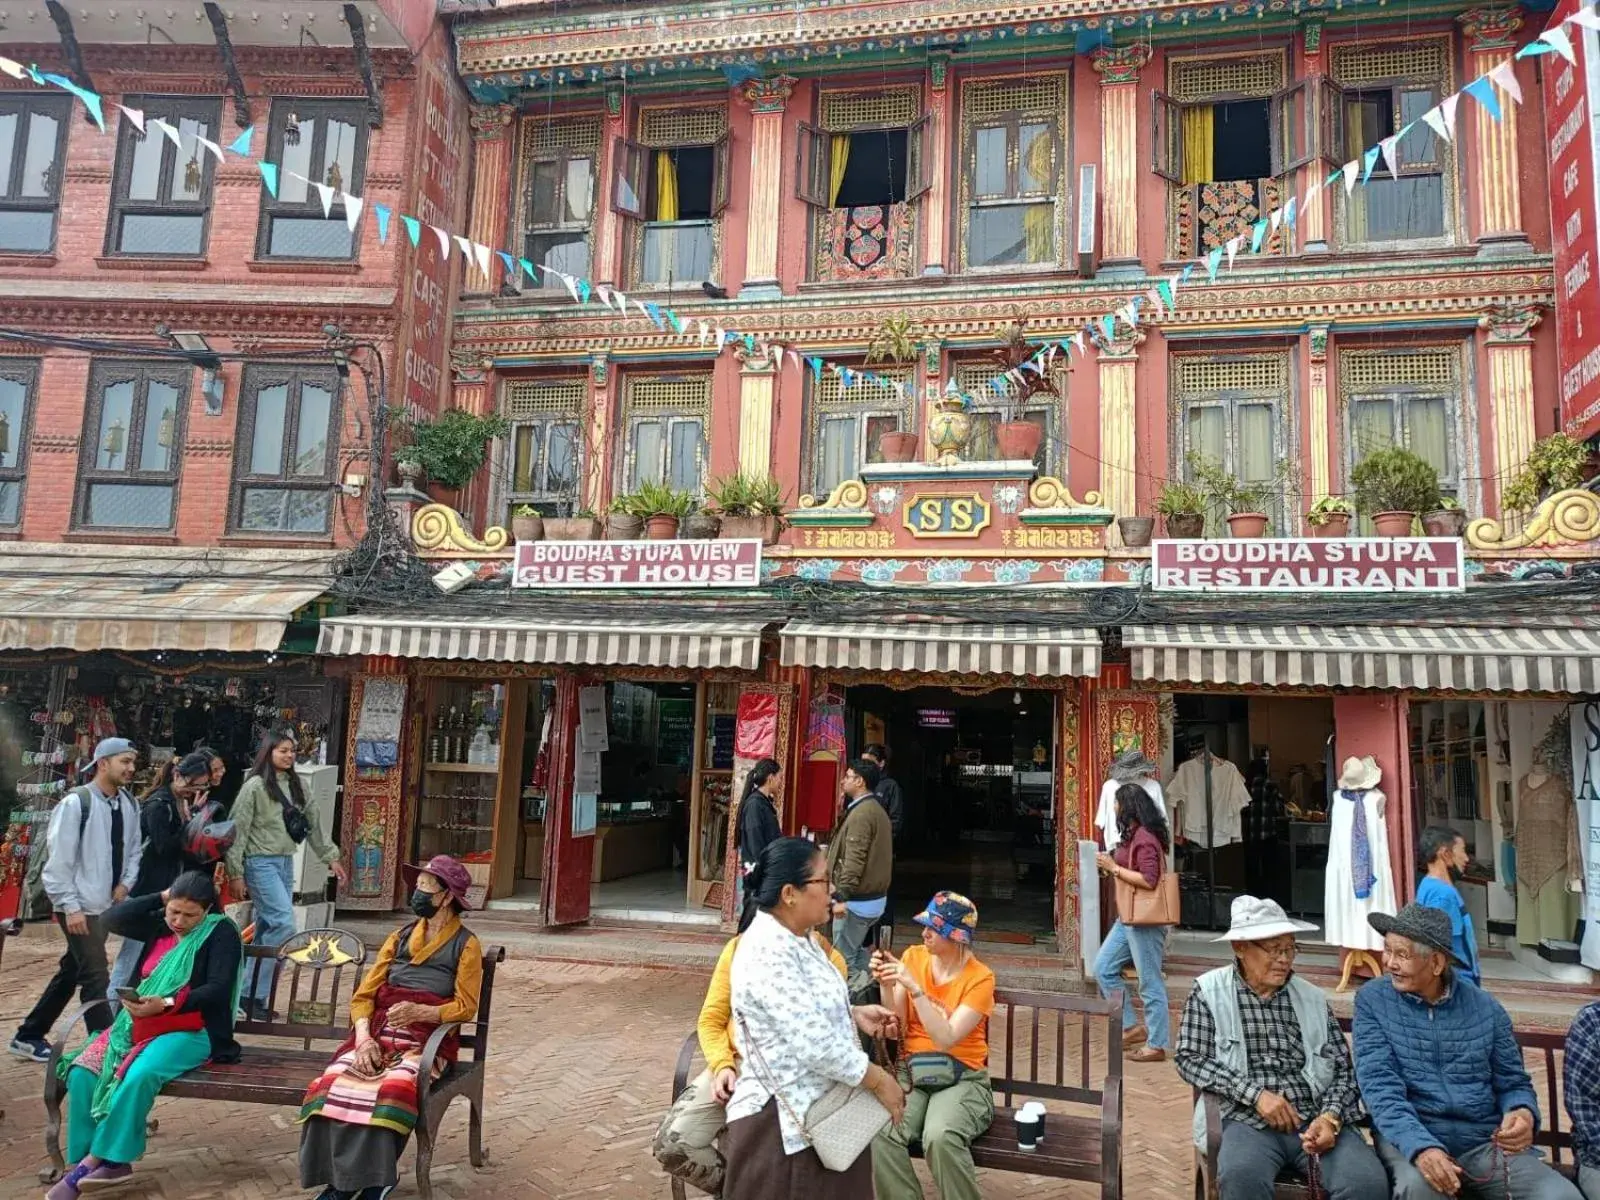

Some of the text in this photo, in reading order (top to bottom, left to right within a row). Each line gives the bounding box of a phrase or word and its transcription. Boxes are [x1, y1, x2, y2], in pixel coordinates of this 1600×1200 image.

[414, 269, 443, 316] CAFE
[404, 348, 440, 396] GUEST
[534, 543, 741, 563] BOUDHA STUPA VIEW
[1176, 541, 1437, 563] BOUDHA STUPA
[518, 564, 755, 583] GUEST HOUSE
[1159, 567, 1457, 588] RESTAURANT
